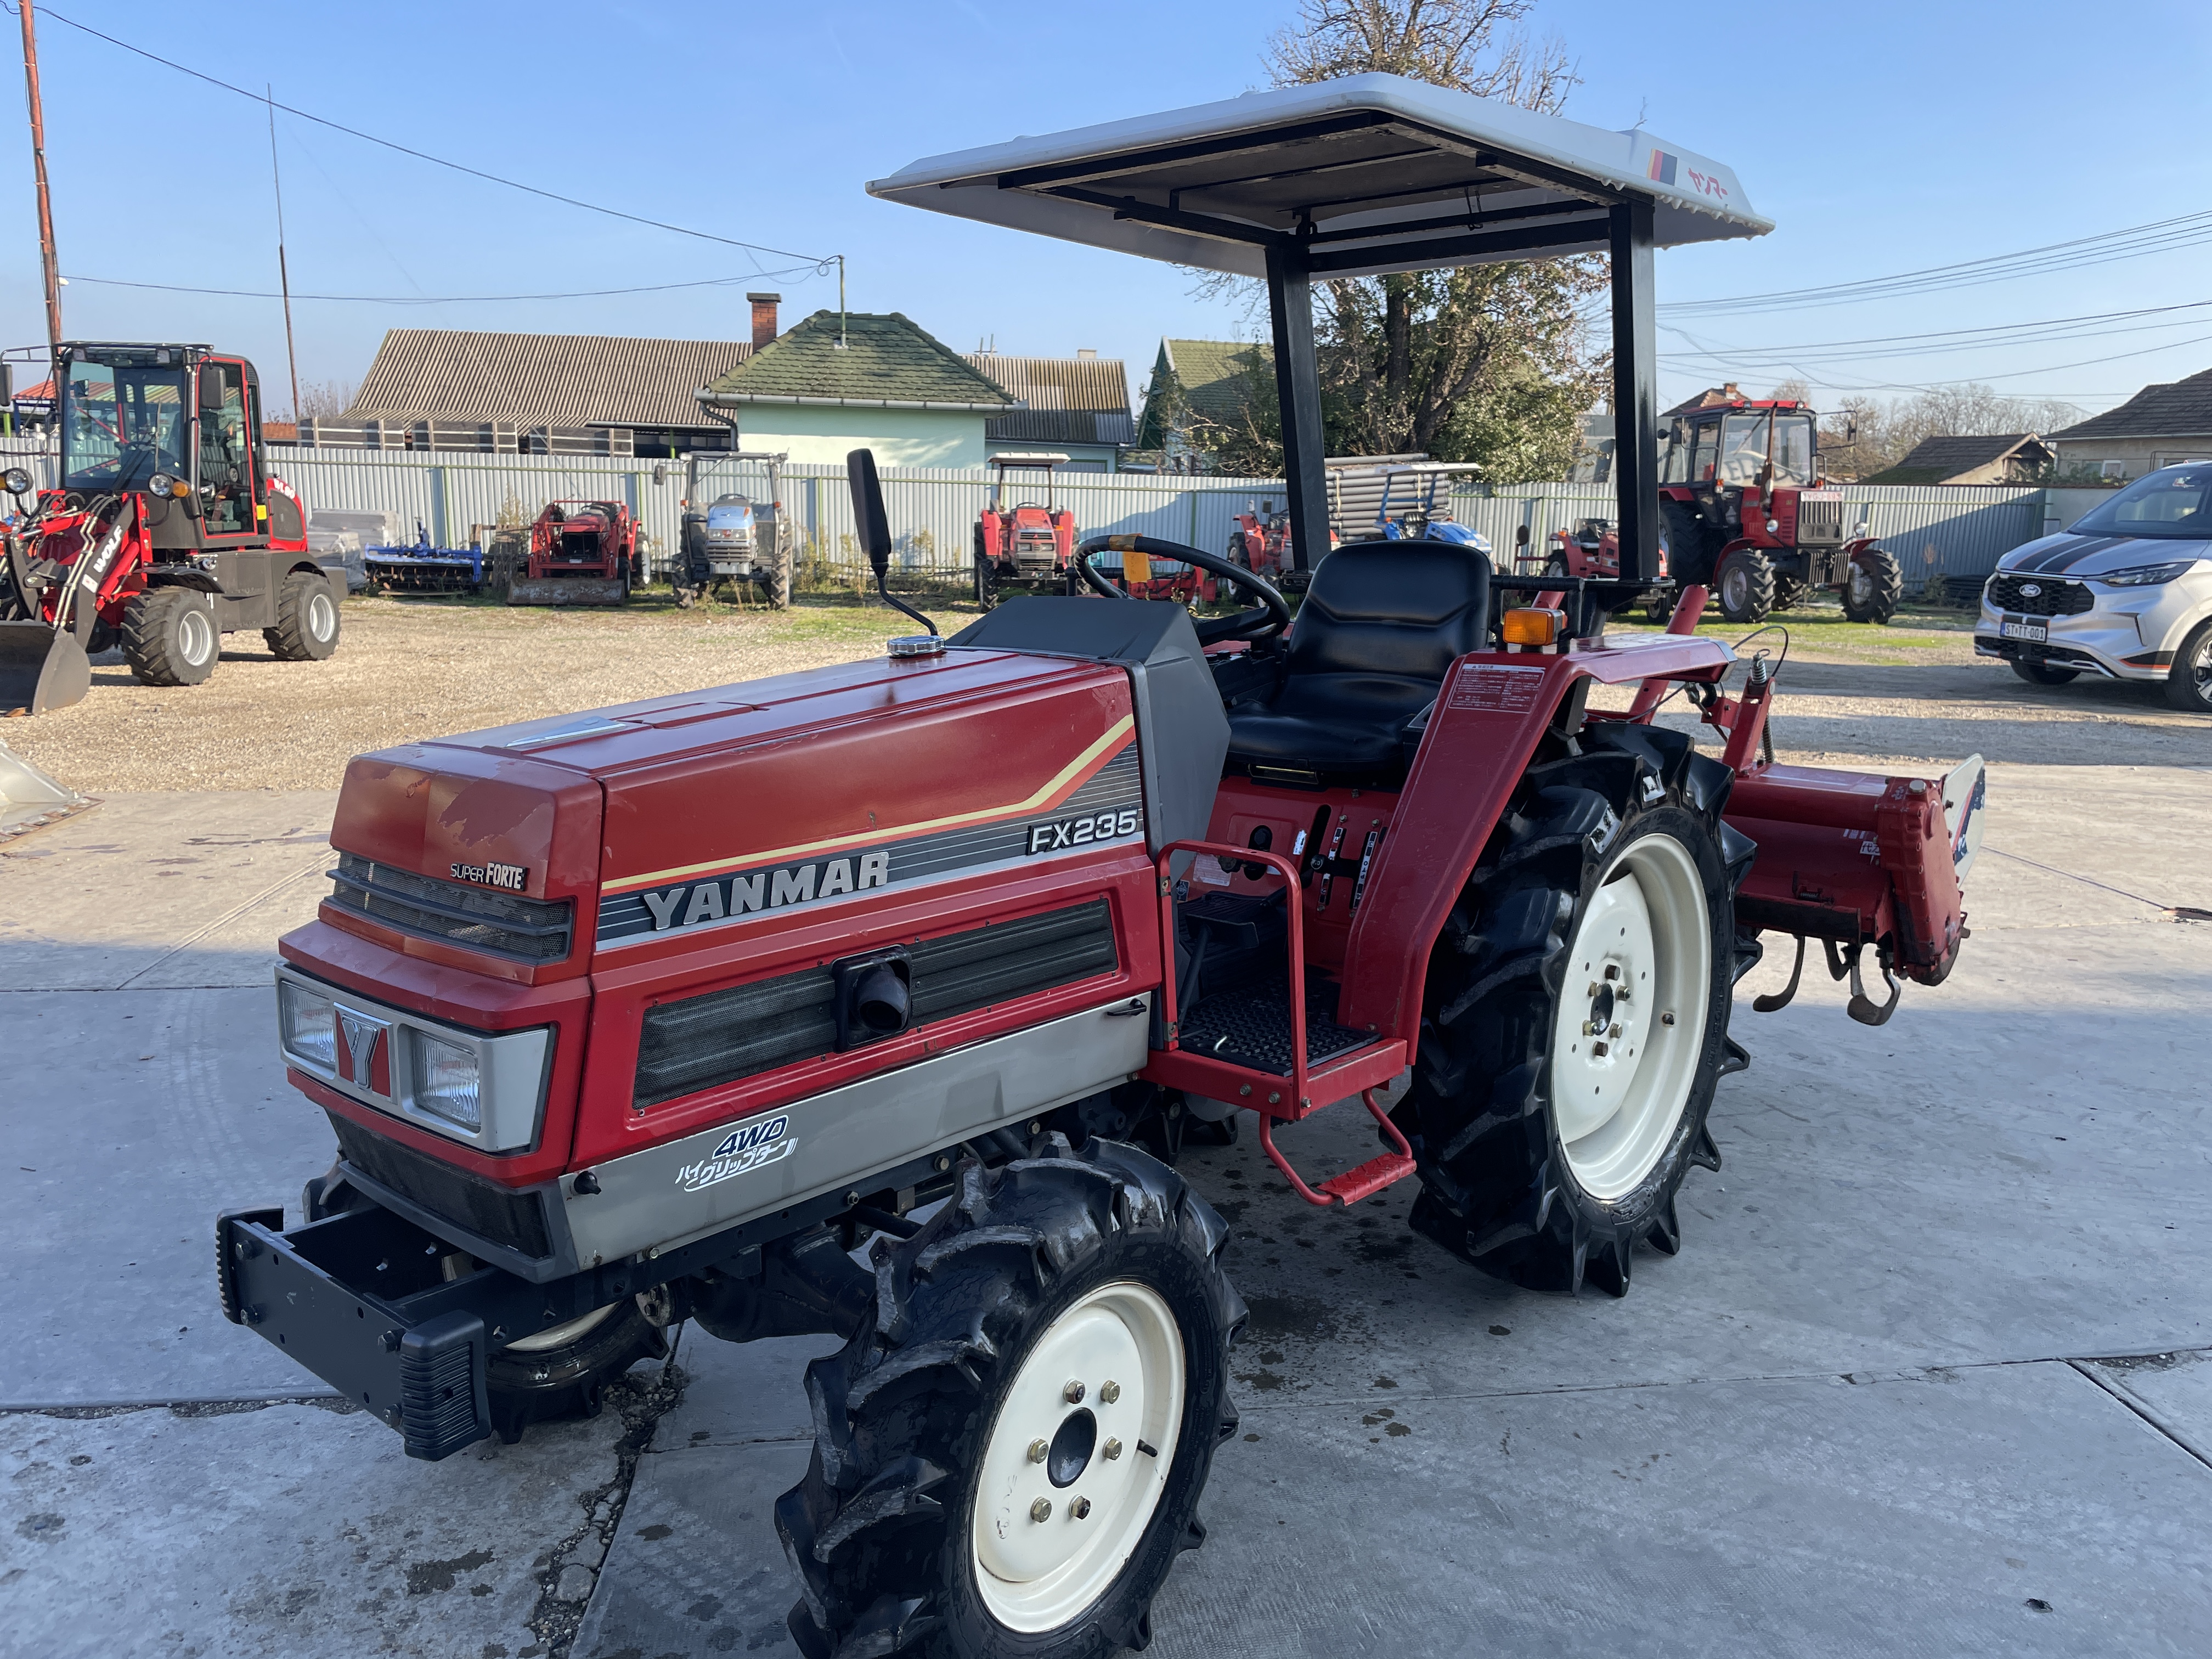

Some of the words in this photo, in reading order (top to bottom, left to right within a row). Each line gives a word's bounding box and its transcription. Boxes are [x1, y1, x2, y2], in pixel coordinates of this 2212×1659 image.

[1688, 167, 1728, 200] ヤンマー
[93, 524, 123, 573] WOLF
[1030, 809, 1138, 853] FX235
[450, 863, 484, 883] SUPER
[485, 862, 523, 889] FORTE
[643, 851, 890, 930] YANMAR
[712, 1115, 789, 1160] 4WD
[674, 1139, 788, 1185] ハイグリップター
